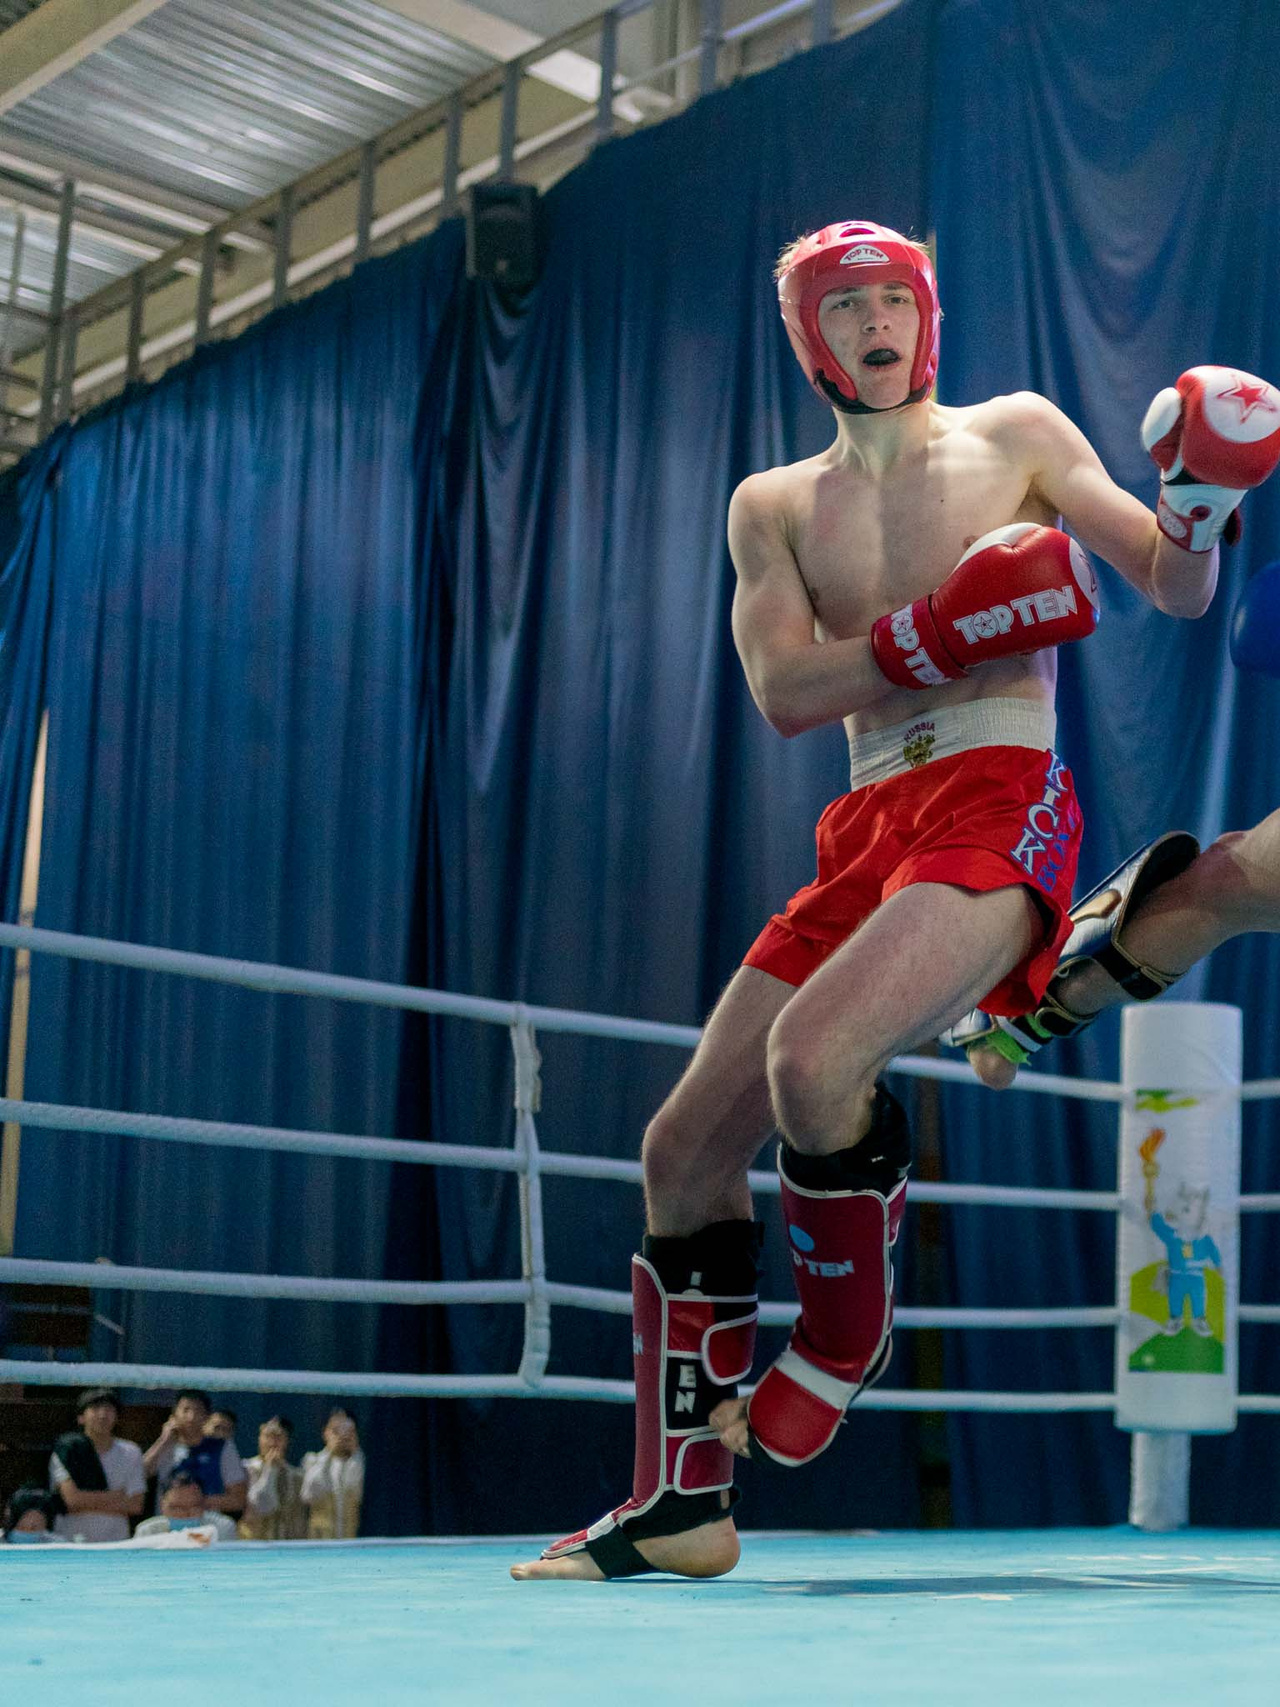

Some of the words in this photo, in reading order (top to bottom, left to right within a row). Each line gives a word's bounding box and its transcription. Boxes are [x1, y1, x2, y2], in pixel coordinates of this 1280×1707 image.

[844, 249, 861, 261] TOP
[862, 248, 884, 258] TEN
[890, 603, 919, 651] TOP
[952, 604, 1014, 645] TOP
[1010, 585, 1078, 626] TEN
[904, 646, 949, 687] TE
[904, 721, 935, 743] RUSSIA
[1010, 748, 1069, 875] KICK
[675, 1364, 697, 1414] EN
